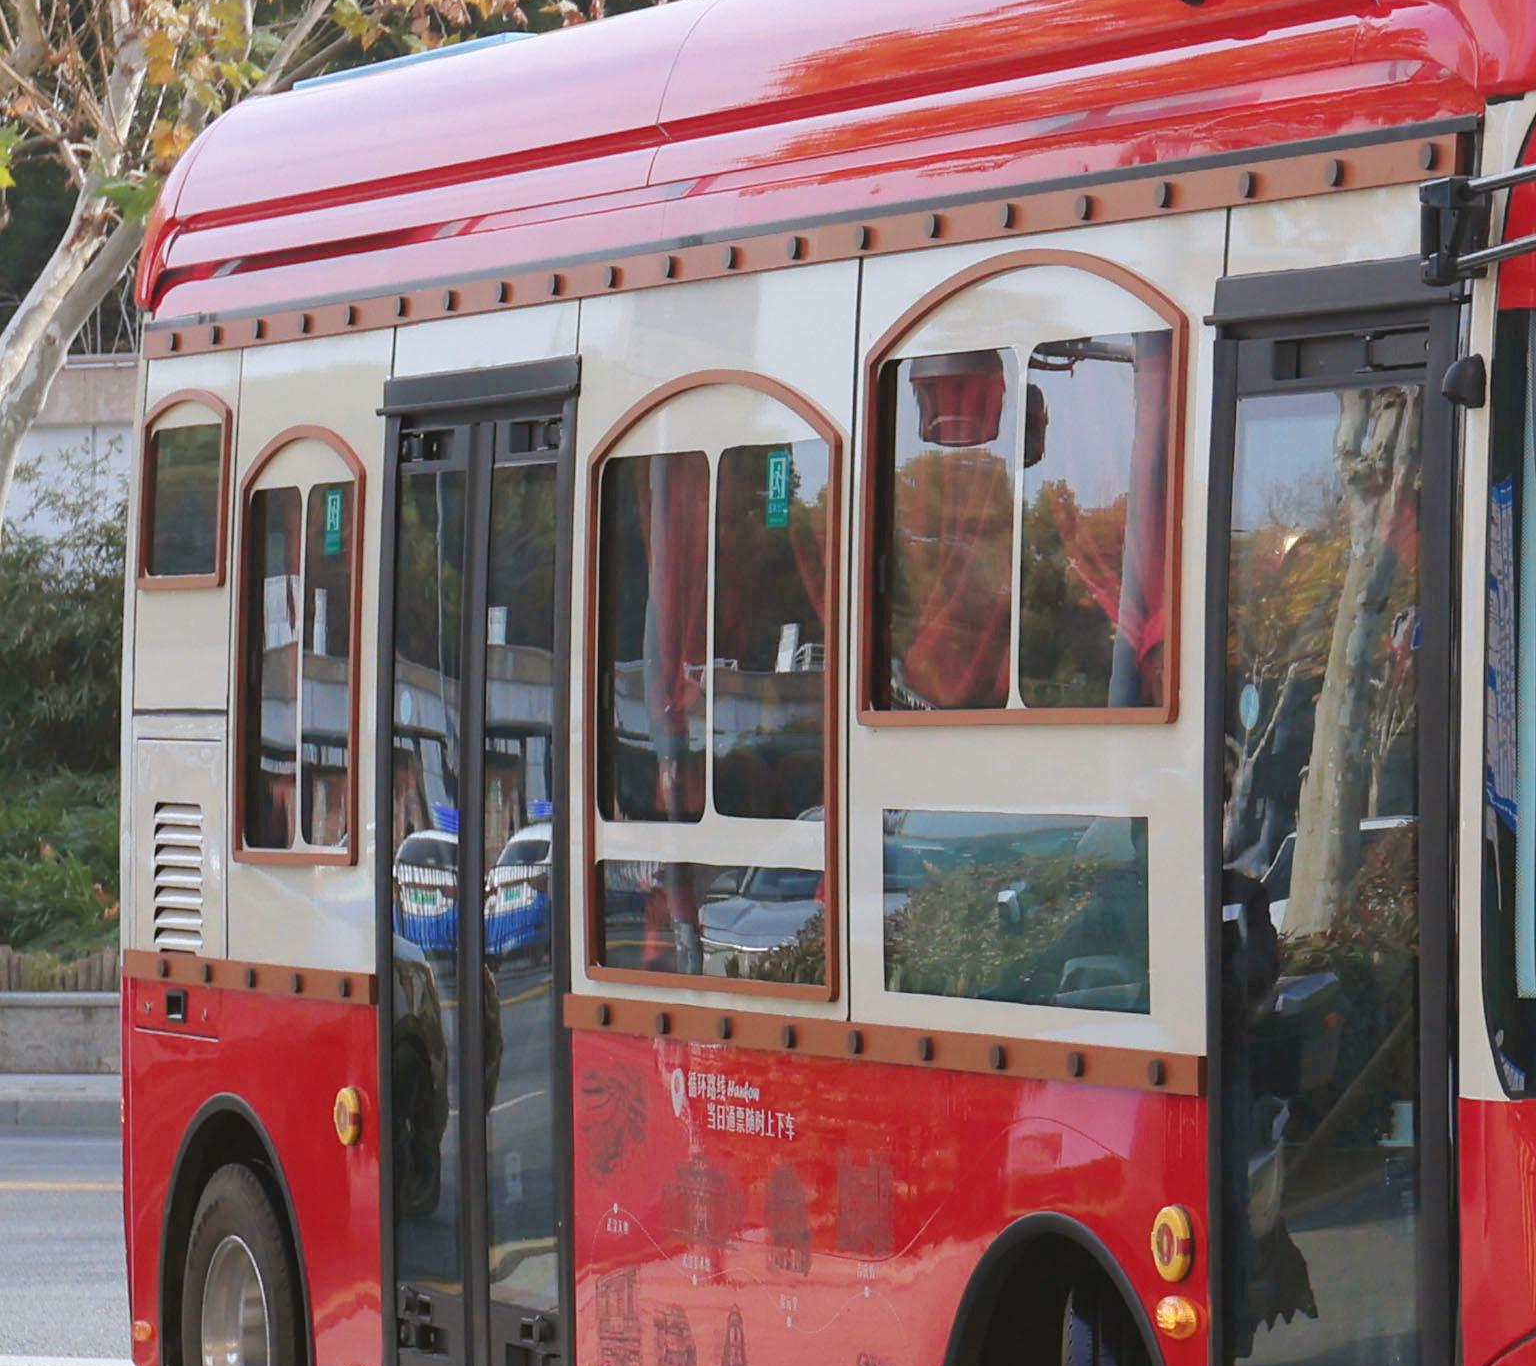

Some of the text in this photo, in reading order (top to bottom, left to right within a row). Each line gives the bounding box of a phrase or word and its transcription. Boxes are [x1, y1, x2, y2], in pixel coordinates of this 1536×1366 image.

[688, 1071, 727, 1101] 循环路线
[708, 1103, 795, 1140] 当日通票随时上下车
